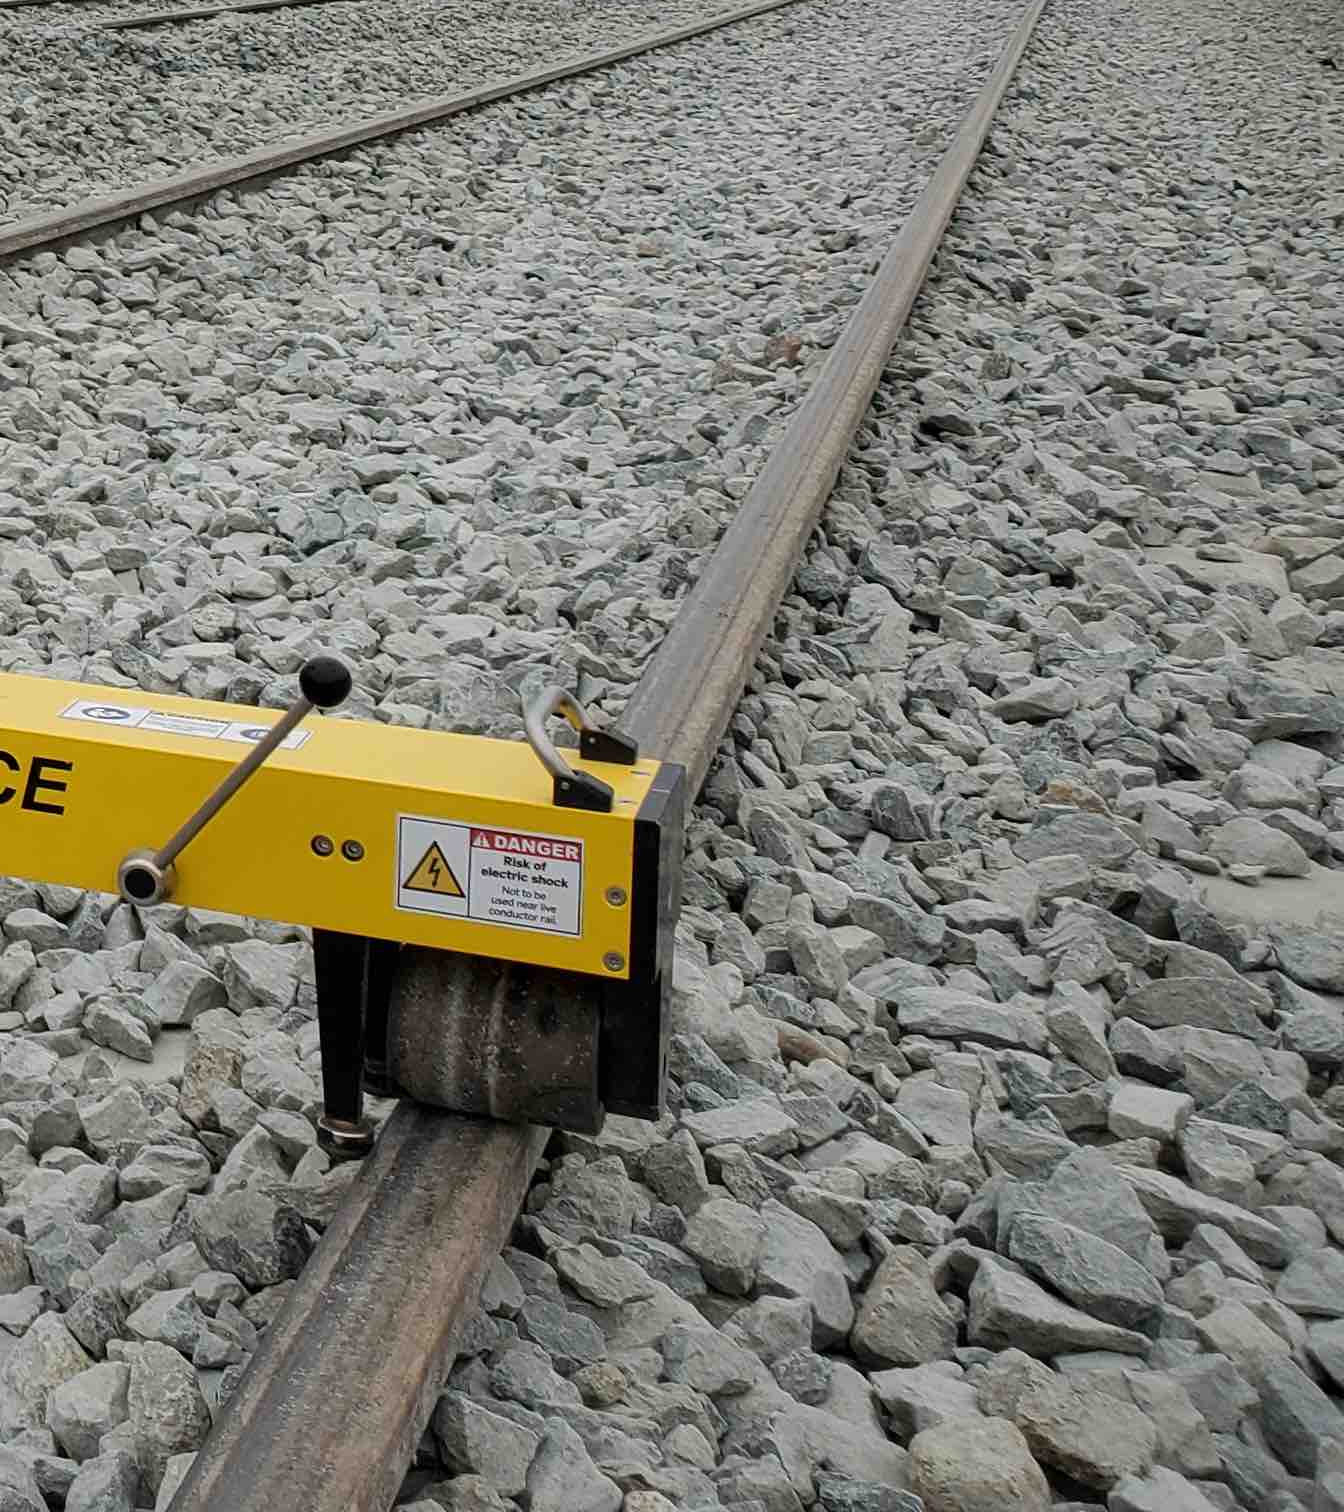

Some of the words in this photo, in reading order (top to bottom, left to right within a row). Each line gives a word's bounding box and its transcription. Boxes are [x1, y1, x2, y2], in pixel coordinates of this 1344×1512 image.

[494, 835, 578, 860] DANGER
[503, 856, 529, 870] Risk
[533, 862, 547, 871] of
[480, 867, 528, 882] electric
[531, 875, 568, 889] shock
[502, 886, 521, 897] Not
[522, 889, 532, 898] to
[534, 891, 546, 901] be
[491, 897, 514, 907] used
[516, 901, 538, 910] near
[540, 904, 557, 914] live
[489, 908, 538, 921] conductor
